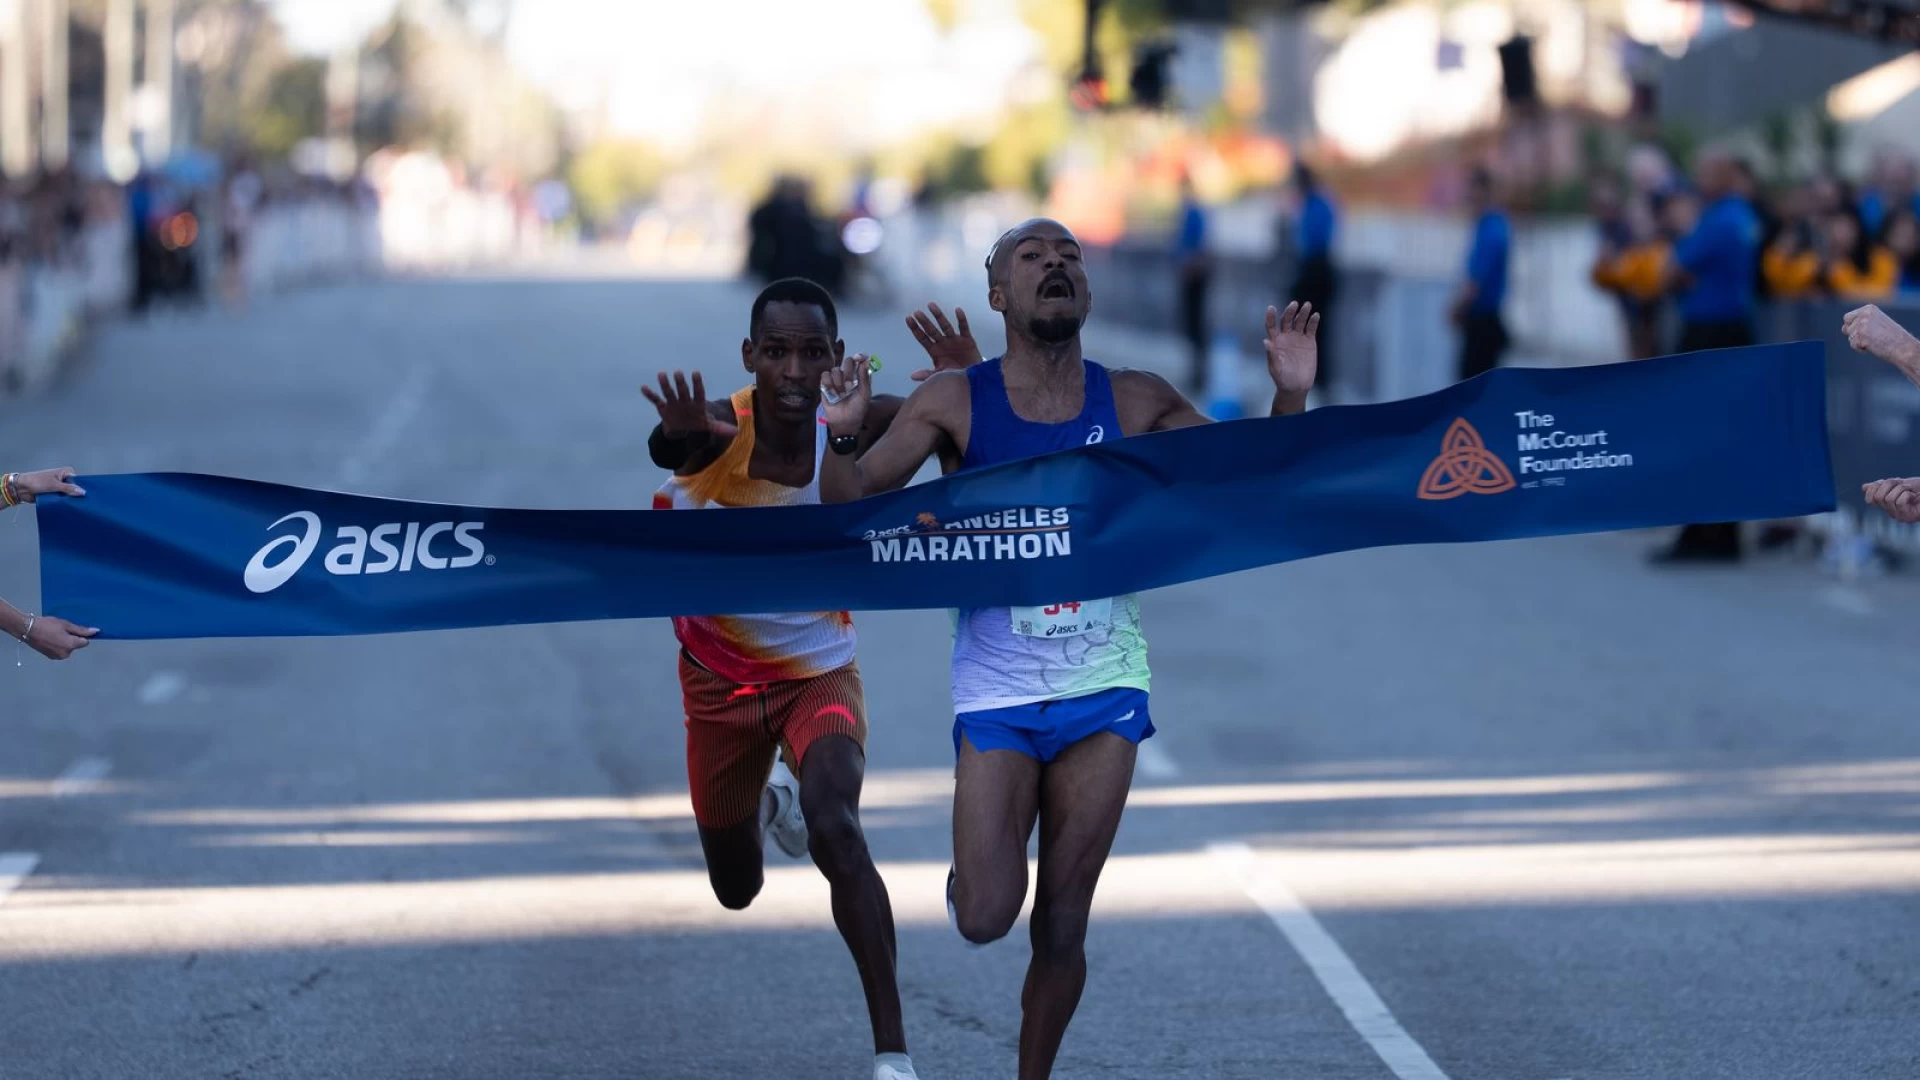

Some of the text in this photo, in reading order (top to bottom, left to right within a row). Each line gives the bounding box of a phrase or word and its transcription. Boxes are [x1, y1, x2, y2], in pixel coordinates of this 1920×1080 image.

[1514, 410, 1555, 428] The
[1517, 430, 1609, 451] McCourt
[1519, 452, 1633, 474] Foundation
[871, 531, 1071, 562] MARATHON
